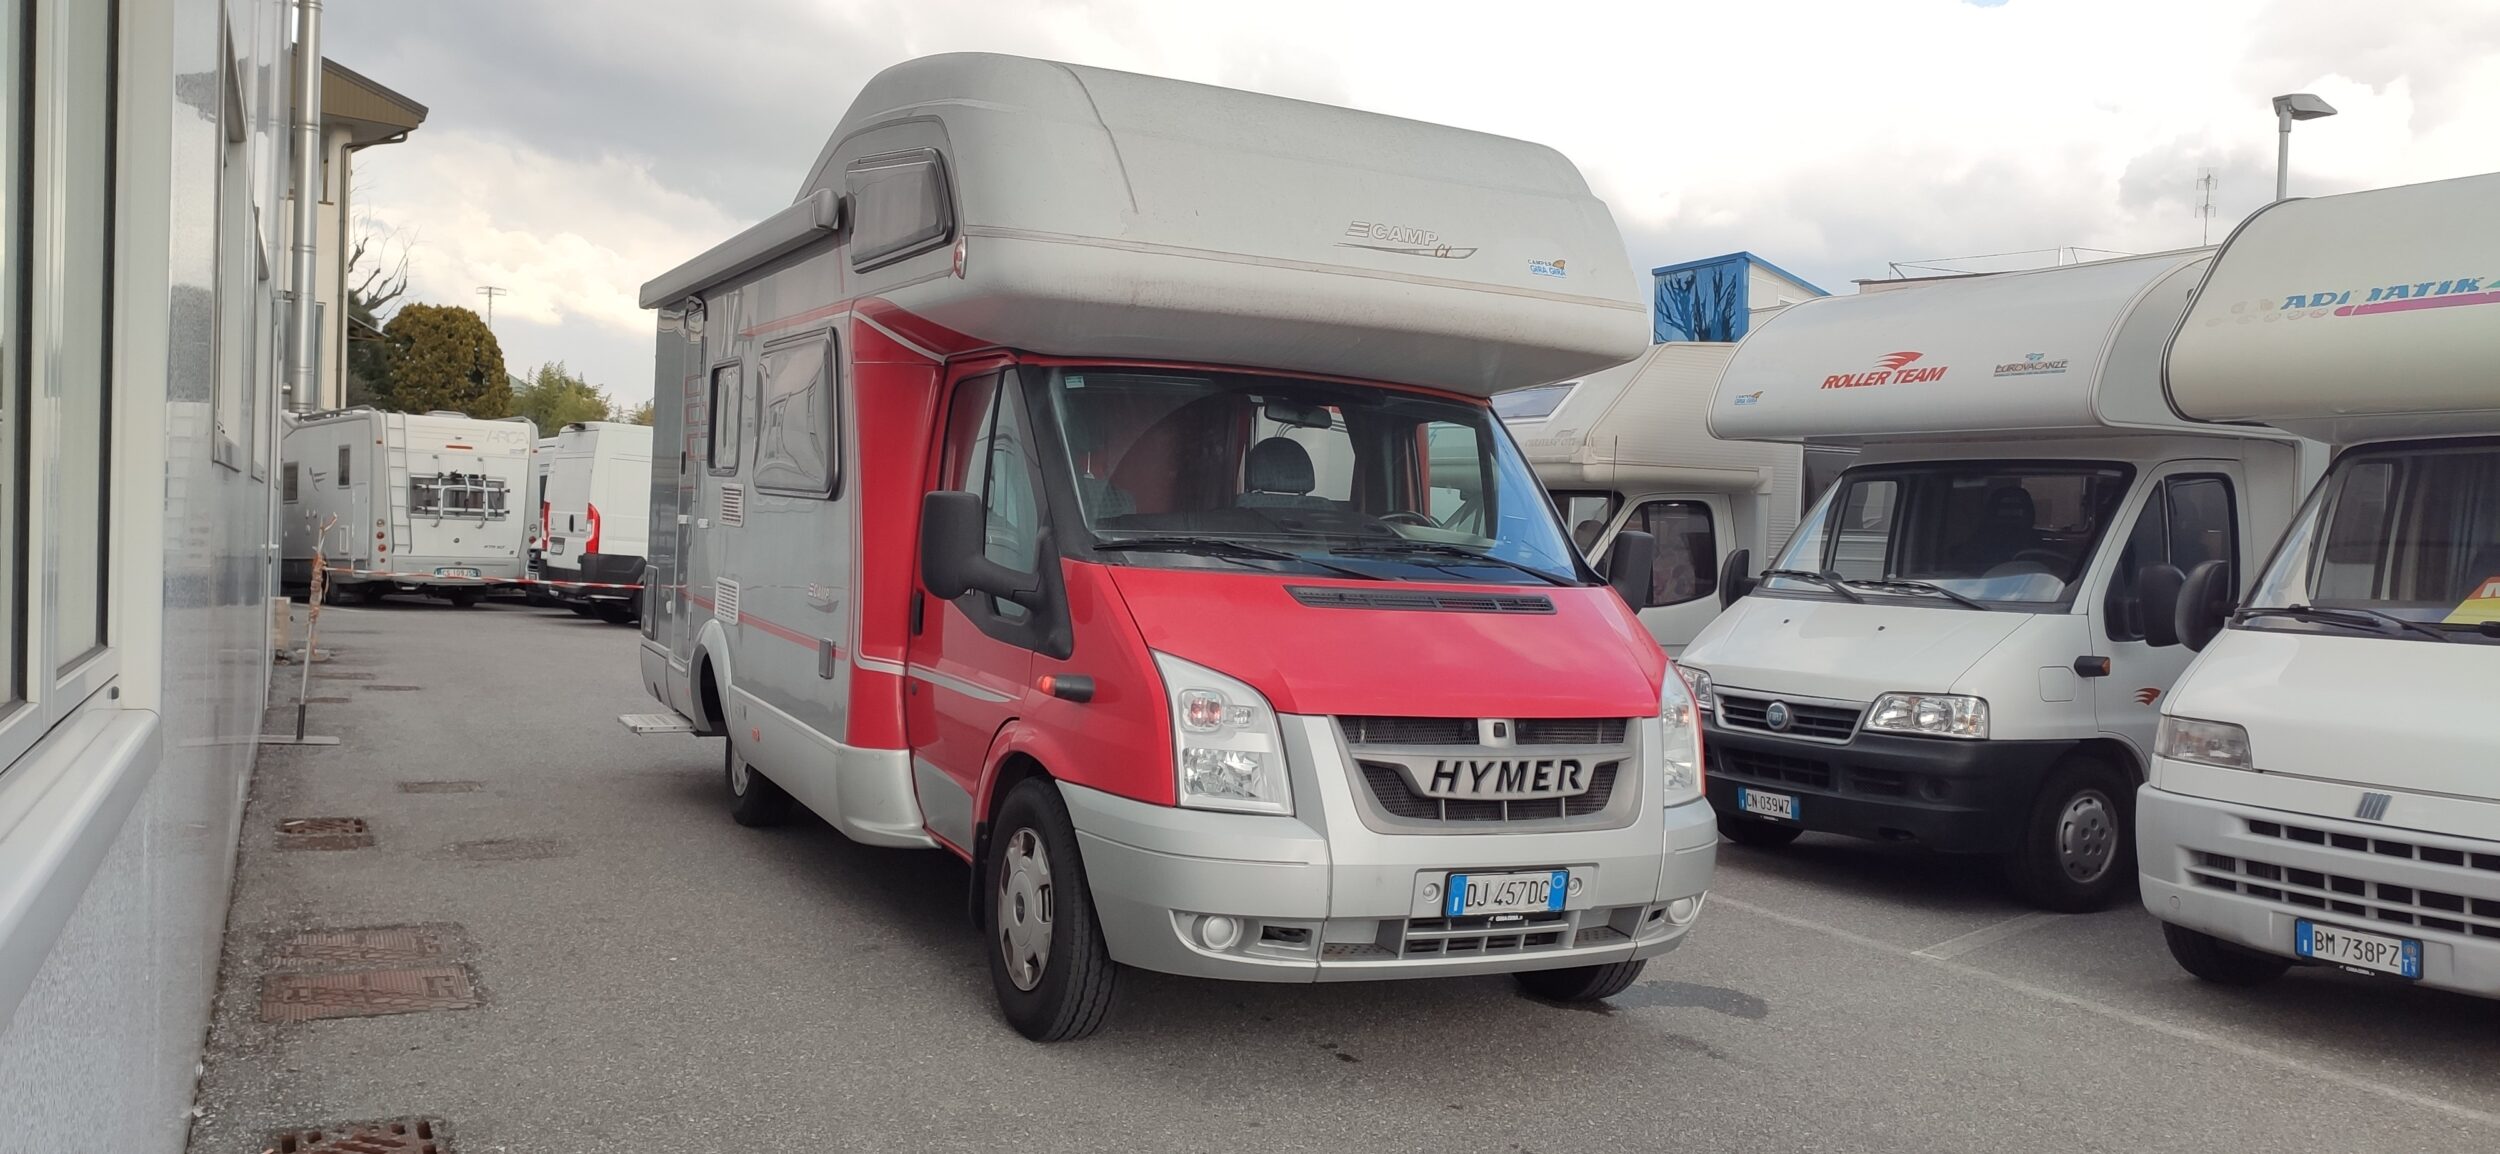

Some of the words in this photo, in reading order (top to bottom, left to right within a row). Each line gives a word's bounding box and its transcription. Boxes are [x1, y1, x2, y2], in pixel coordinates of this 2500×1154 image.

[1820, 371, 1892, 390] ROLLER
[1892, 366, 1948, 385] TEAM
[1430, 758, 1583, 794] HYMER
[1746, 792, 1758, 809] CN
[1760, 795, 1791, 815] 039WZ
[1465, 882, 1489, 907] DJ
[2314, 930, 2336, 955] BM
[2341, 936, 2400, 968] 738PZ
